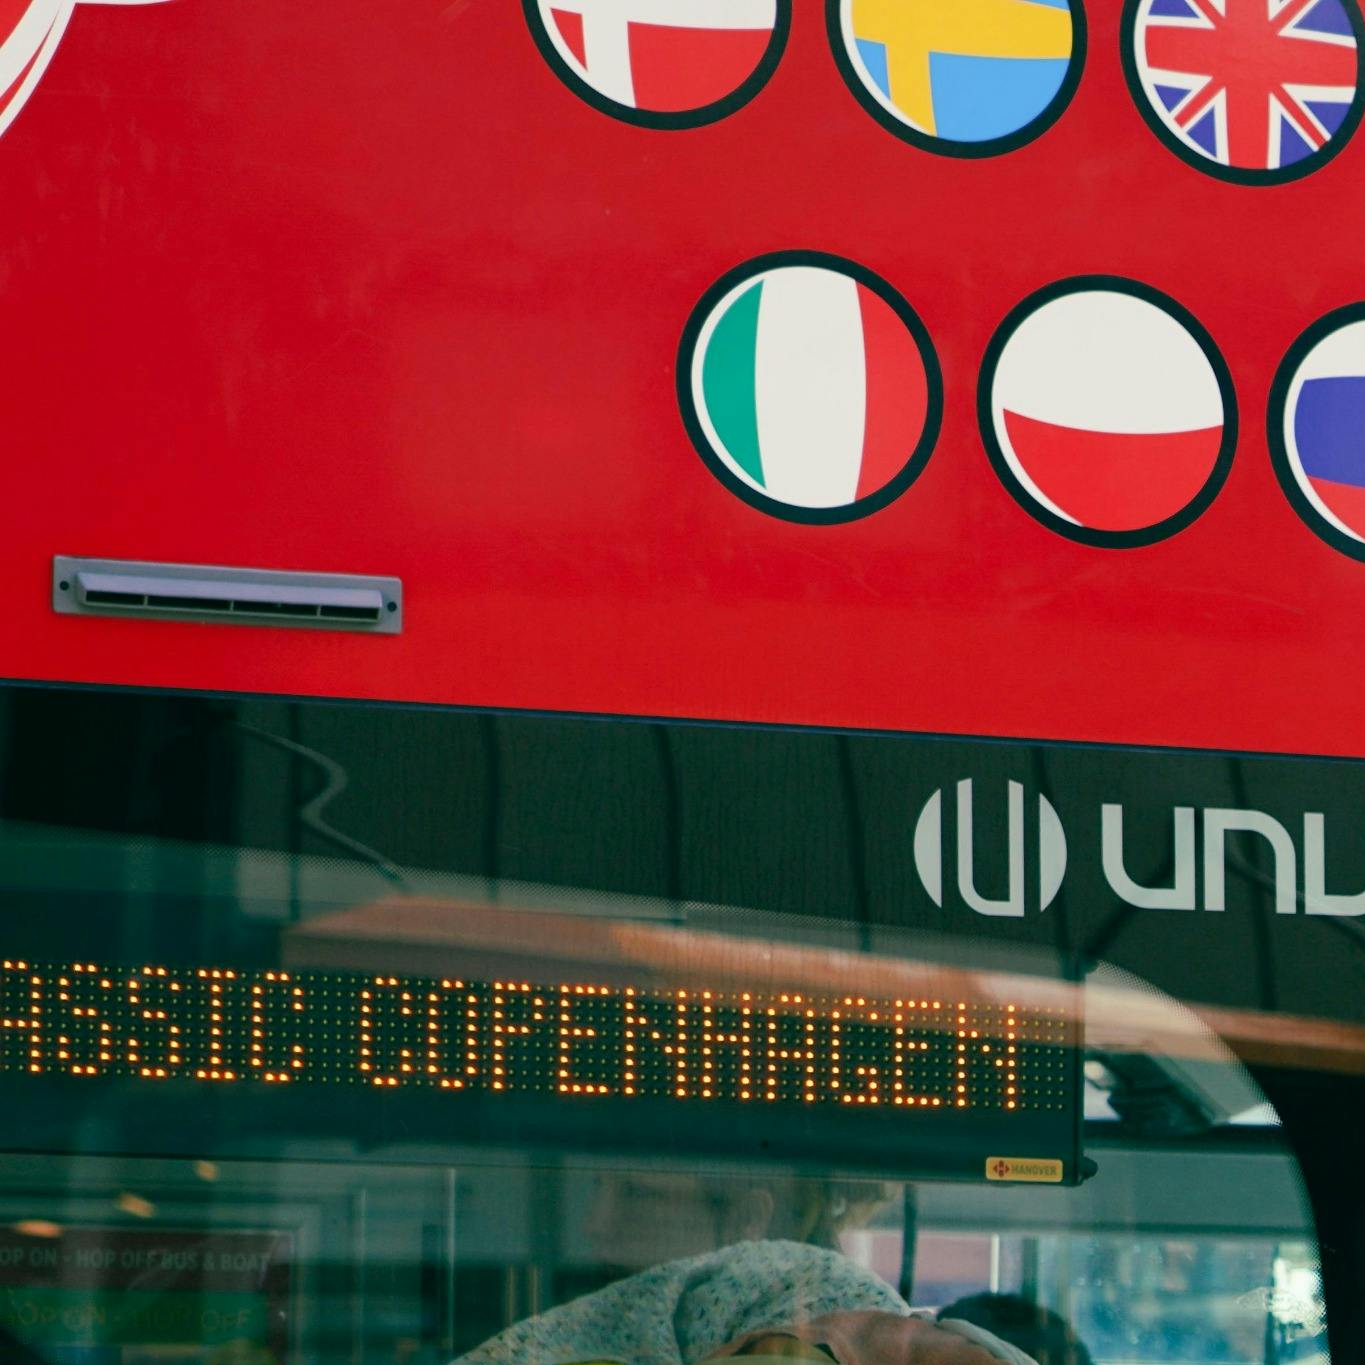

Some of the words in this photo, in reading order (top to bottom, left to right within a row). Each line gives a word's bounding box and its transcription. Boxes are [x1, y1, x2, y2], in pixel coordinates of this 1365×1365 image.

[361, 976, 1018, 1109] COPENHAGEN
[30, 1250, 57, 1267] ON
[76, 1250, 115, 1268] HOP
[121, 1250, 154, 1269] OFF
[161, 1251, 198, 1270] BUS
[203, 1252, 216, 1271] &
[221, 1253, 270, 1272] BOAT
